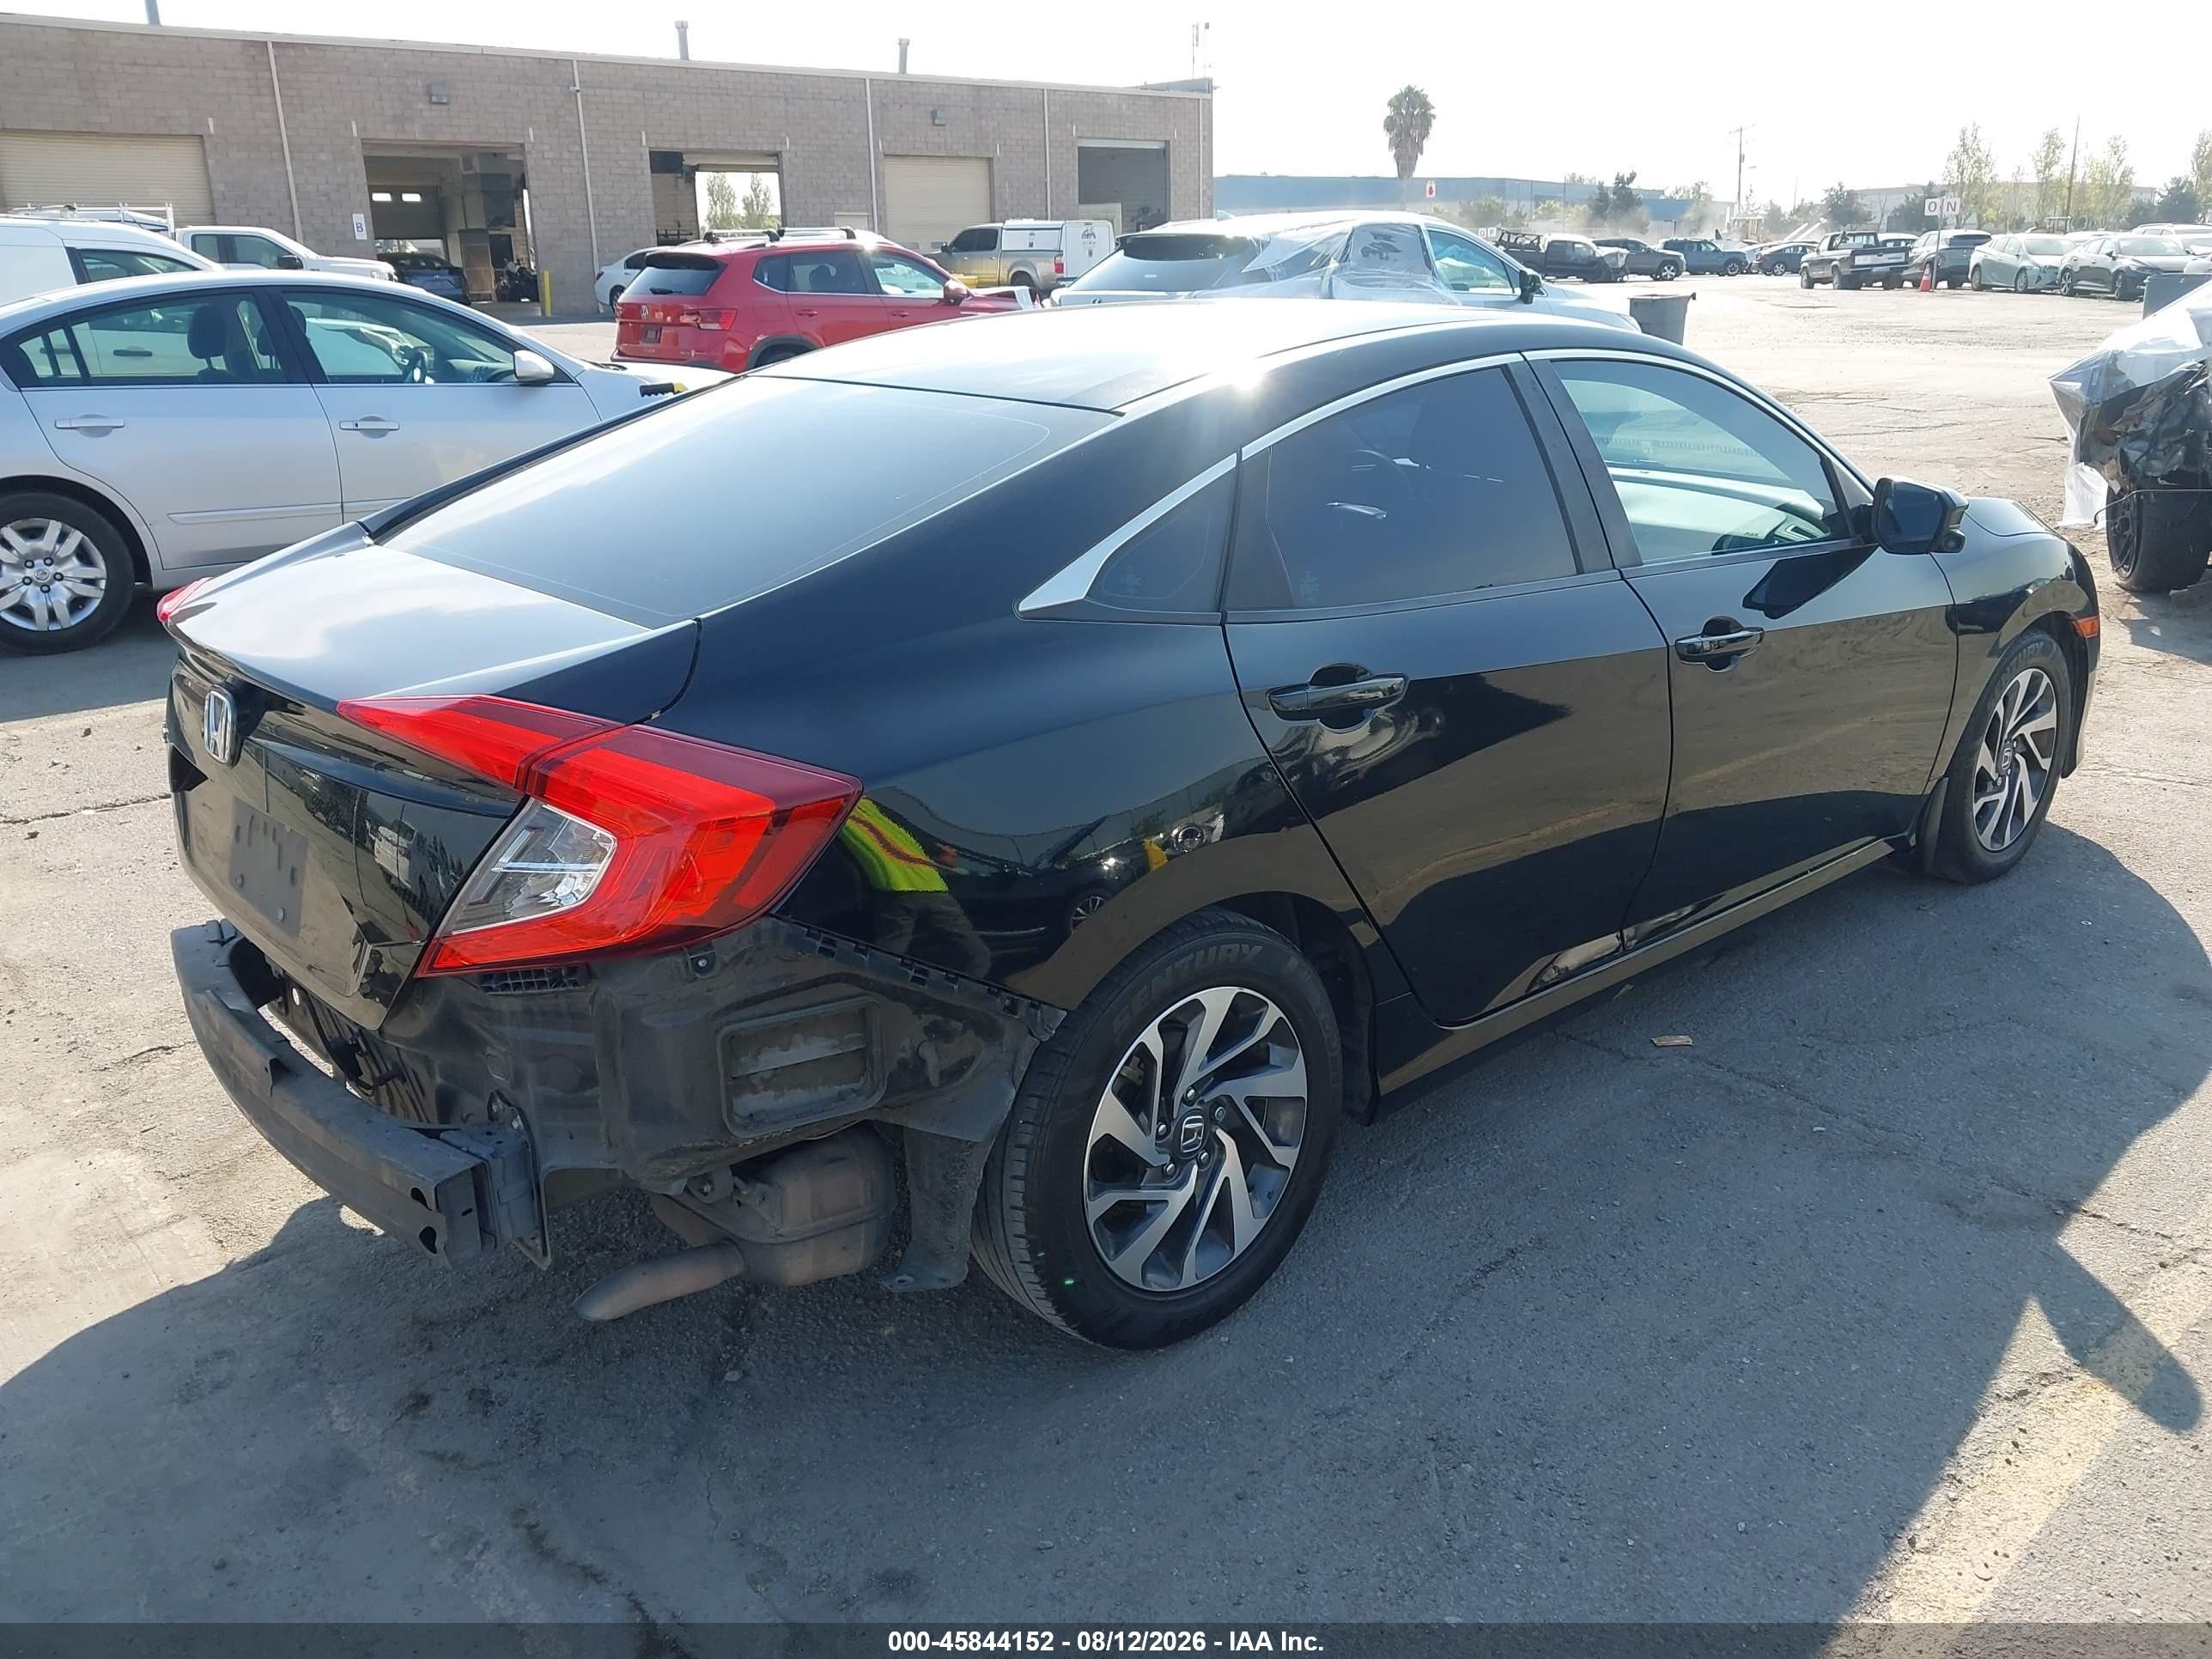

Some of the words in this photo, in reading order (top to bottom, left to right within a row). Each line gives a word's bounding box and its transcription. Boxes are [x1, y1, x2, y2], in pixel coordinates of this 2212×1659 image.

[1947, 201, 1957, 212] N
[356, 222, 364, 233] B
[1112, 943, 1264, 1036] SENTURY
